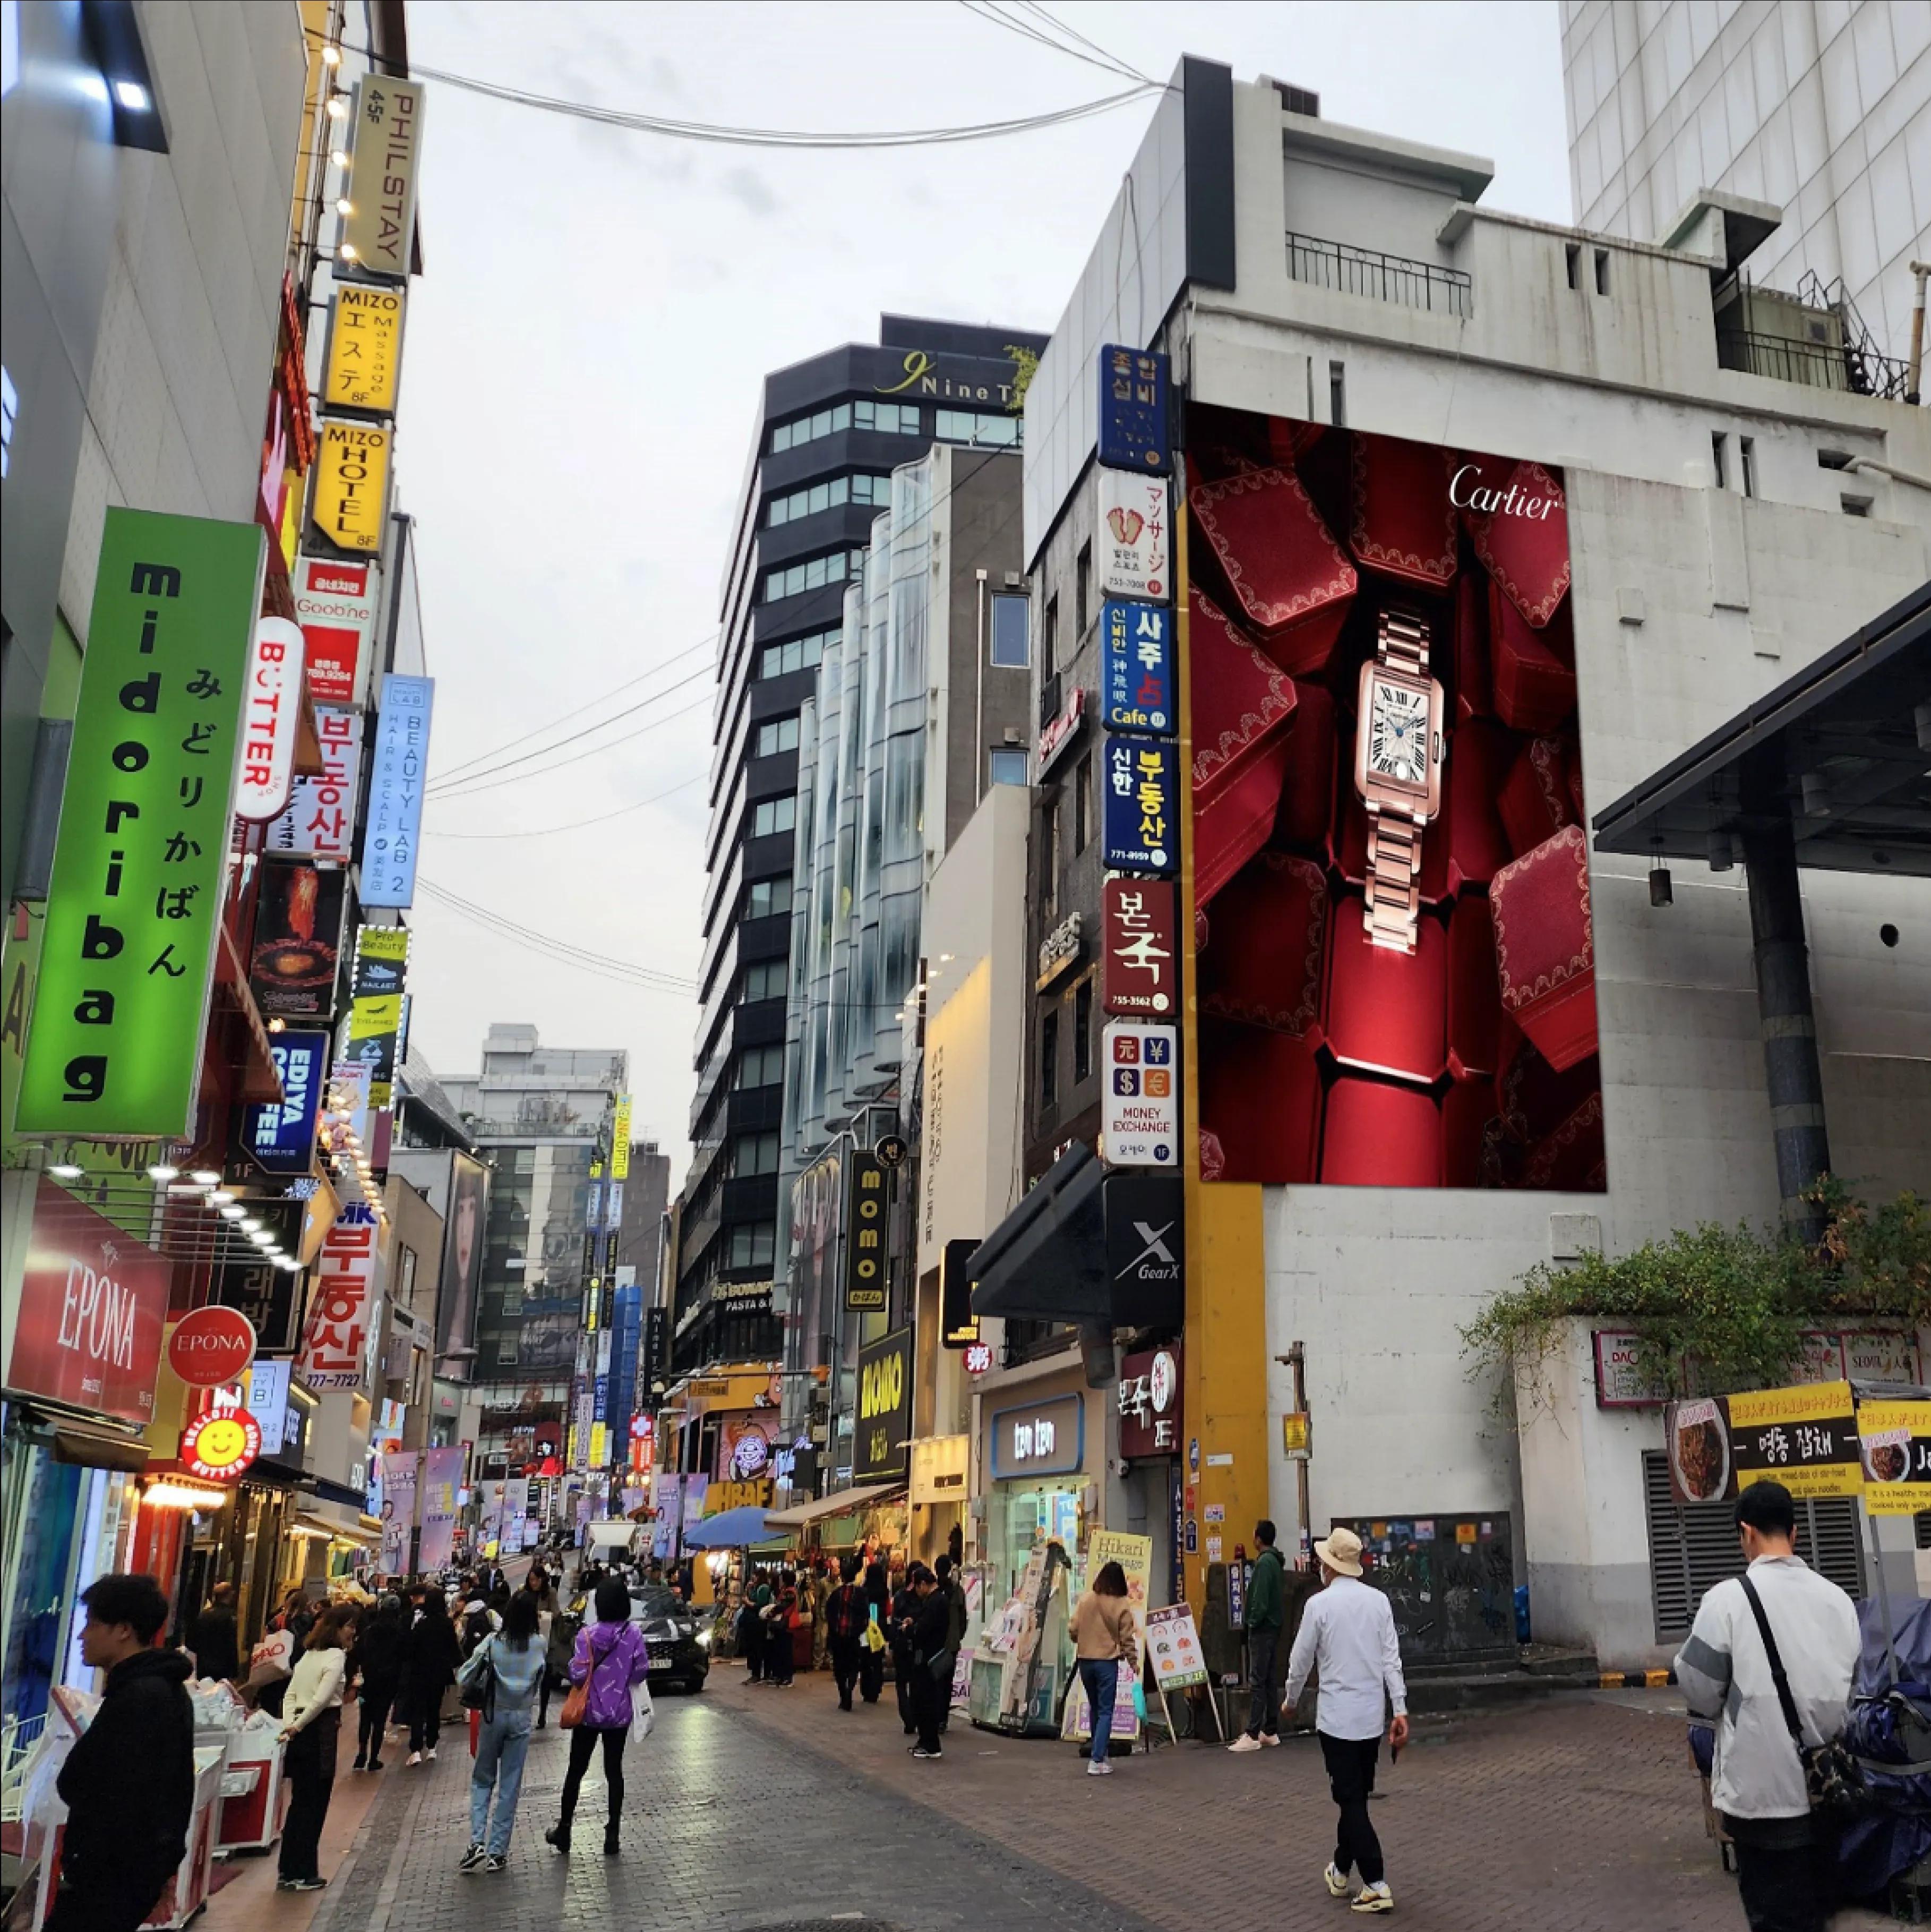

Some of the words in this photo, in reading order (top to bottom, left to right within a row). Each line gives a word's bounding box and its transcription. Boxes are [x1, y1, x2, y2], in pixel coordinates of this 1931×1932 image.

[377, 93, 414, 260] PHILSTAY
[341, 290, 398, 311] MIZO
[338, 311, 366, 391] エステ
[922, 376, 988, 400] Nine
[328, 427, 384, 447] MIZO
[336, 445, 368, 533] HOTEL
[1449, 464, 1561, 520] Cartier
[1146, 486, 1164, 574] マッサージ
[1136, 611, 1163, 671] 사주
[385, 714, 399, 755] HAIR
[1111, 707, 1148, 726] Cafe
[306, 715, 353, 851] 부동산
[400, 715, 421, 809] BEAUTY
[1111, 747, 1135, 797] 신한
[148, 669, 222, 977] みどりかばん
[1136, 749, 1166, 847] 부동산
[62, 561, 182, 1102] midoribag
[394, 817, 410, 864] LAB
[391, 876, 404, 893] 2
[1113, 892, 1171, 985] 본죽
[1119, 1039, 1136, 1060] 元
[282, 1049, 311, 1125] EDIYA
[1122, 1107, 1161, 1118] MONEY
[1112, 1121, 1172, 1133] EXCHANGE
[857, 1169, 881, 1278] momo
[57, 1257, 137, 1370] EPONA
[311, 1227, 372, 1370] 부동산
[726, 1300, 756, 1311] PASTA
[176, 1333, 247, 1352] EPONA
[306, 1374, 361, 1388] 777-7727
[191, 1459, 247, 1478] BUTTER
[243, 1423, 259, 1458] SHOP
[1758, 1426, 1789, 1464] 명동
[1795, 1426, 1834, 1460] 잡채
[1099, 1537, 1145, 1557] Hikari
